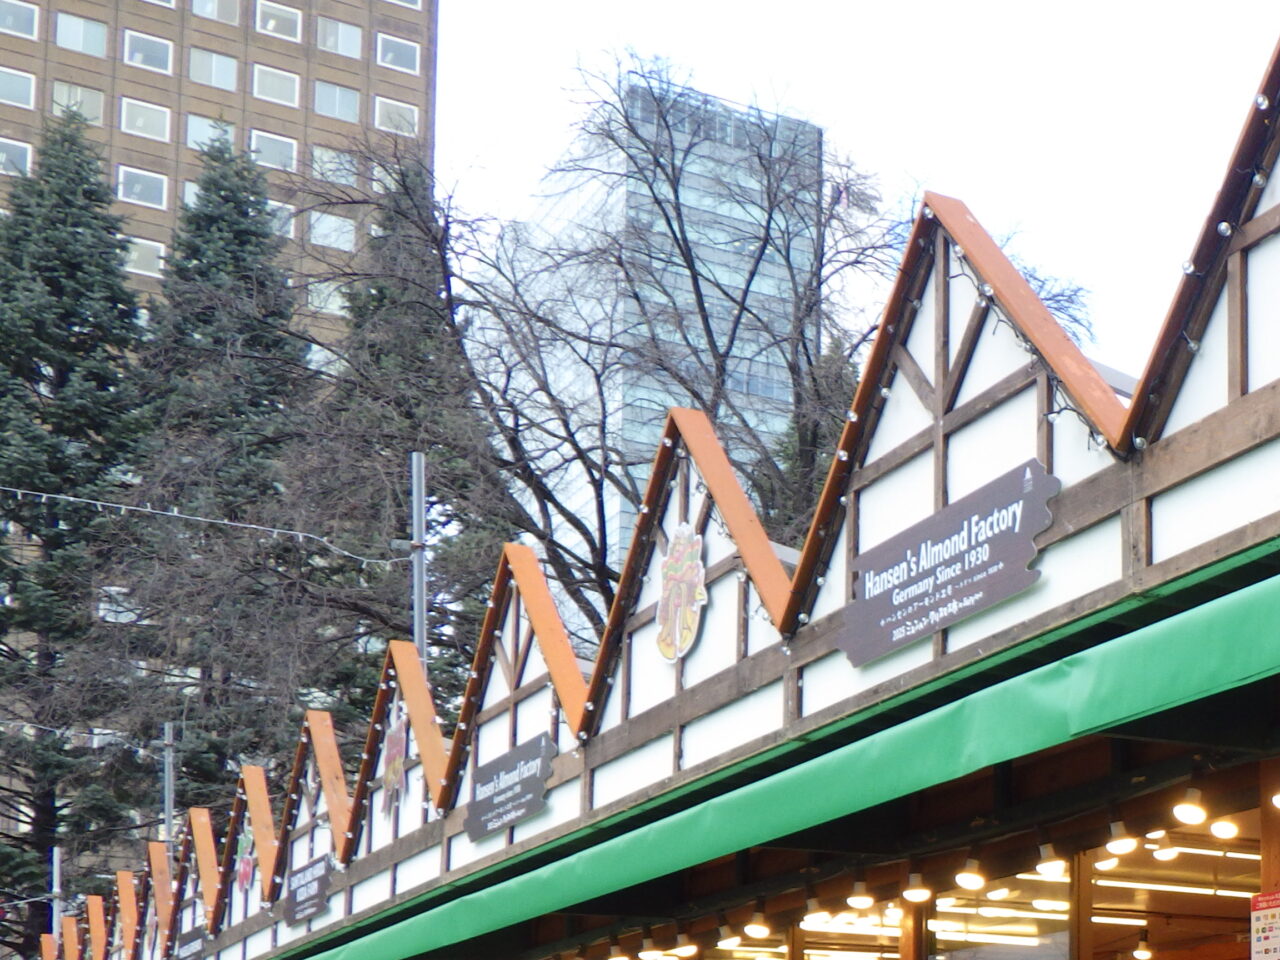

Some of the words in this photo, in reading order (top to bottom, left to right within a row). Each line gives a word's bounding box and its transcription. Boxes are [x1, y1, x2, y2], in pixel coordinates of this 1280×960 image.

[865, 550, 917, 600] Hansen's
[919, 521, 968, 573] Almond
[971, 500, 1024, 546] Factory
[892, 576, 935, 606] Germany
[936, 563, 962, 585] Since
[964, 544, 990, 570] 1930
